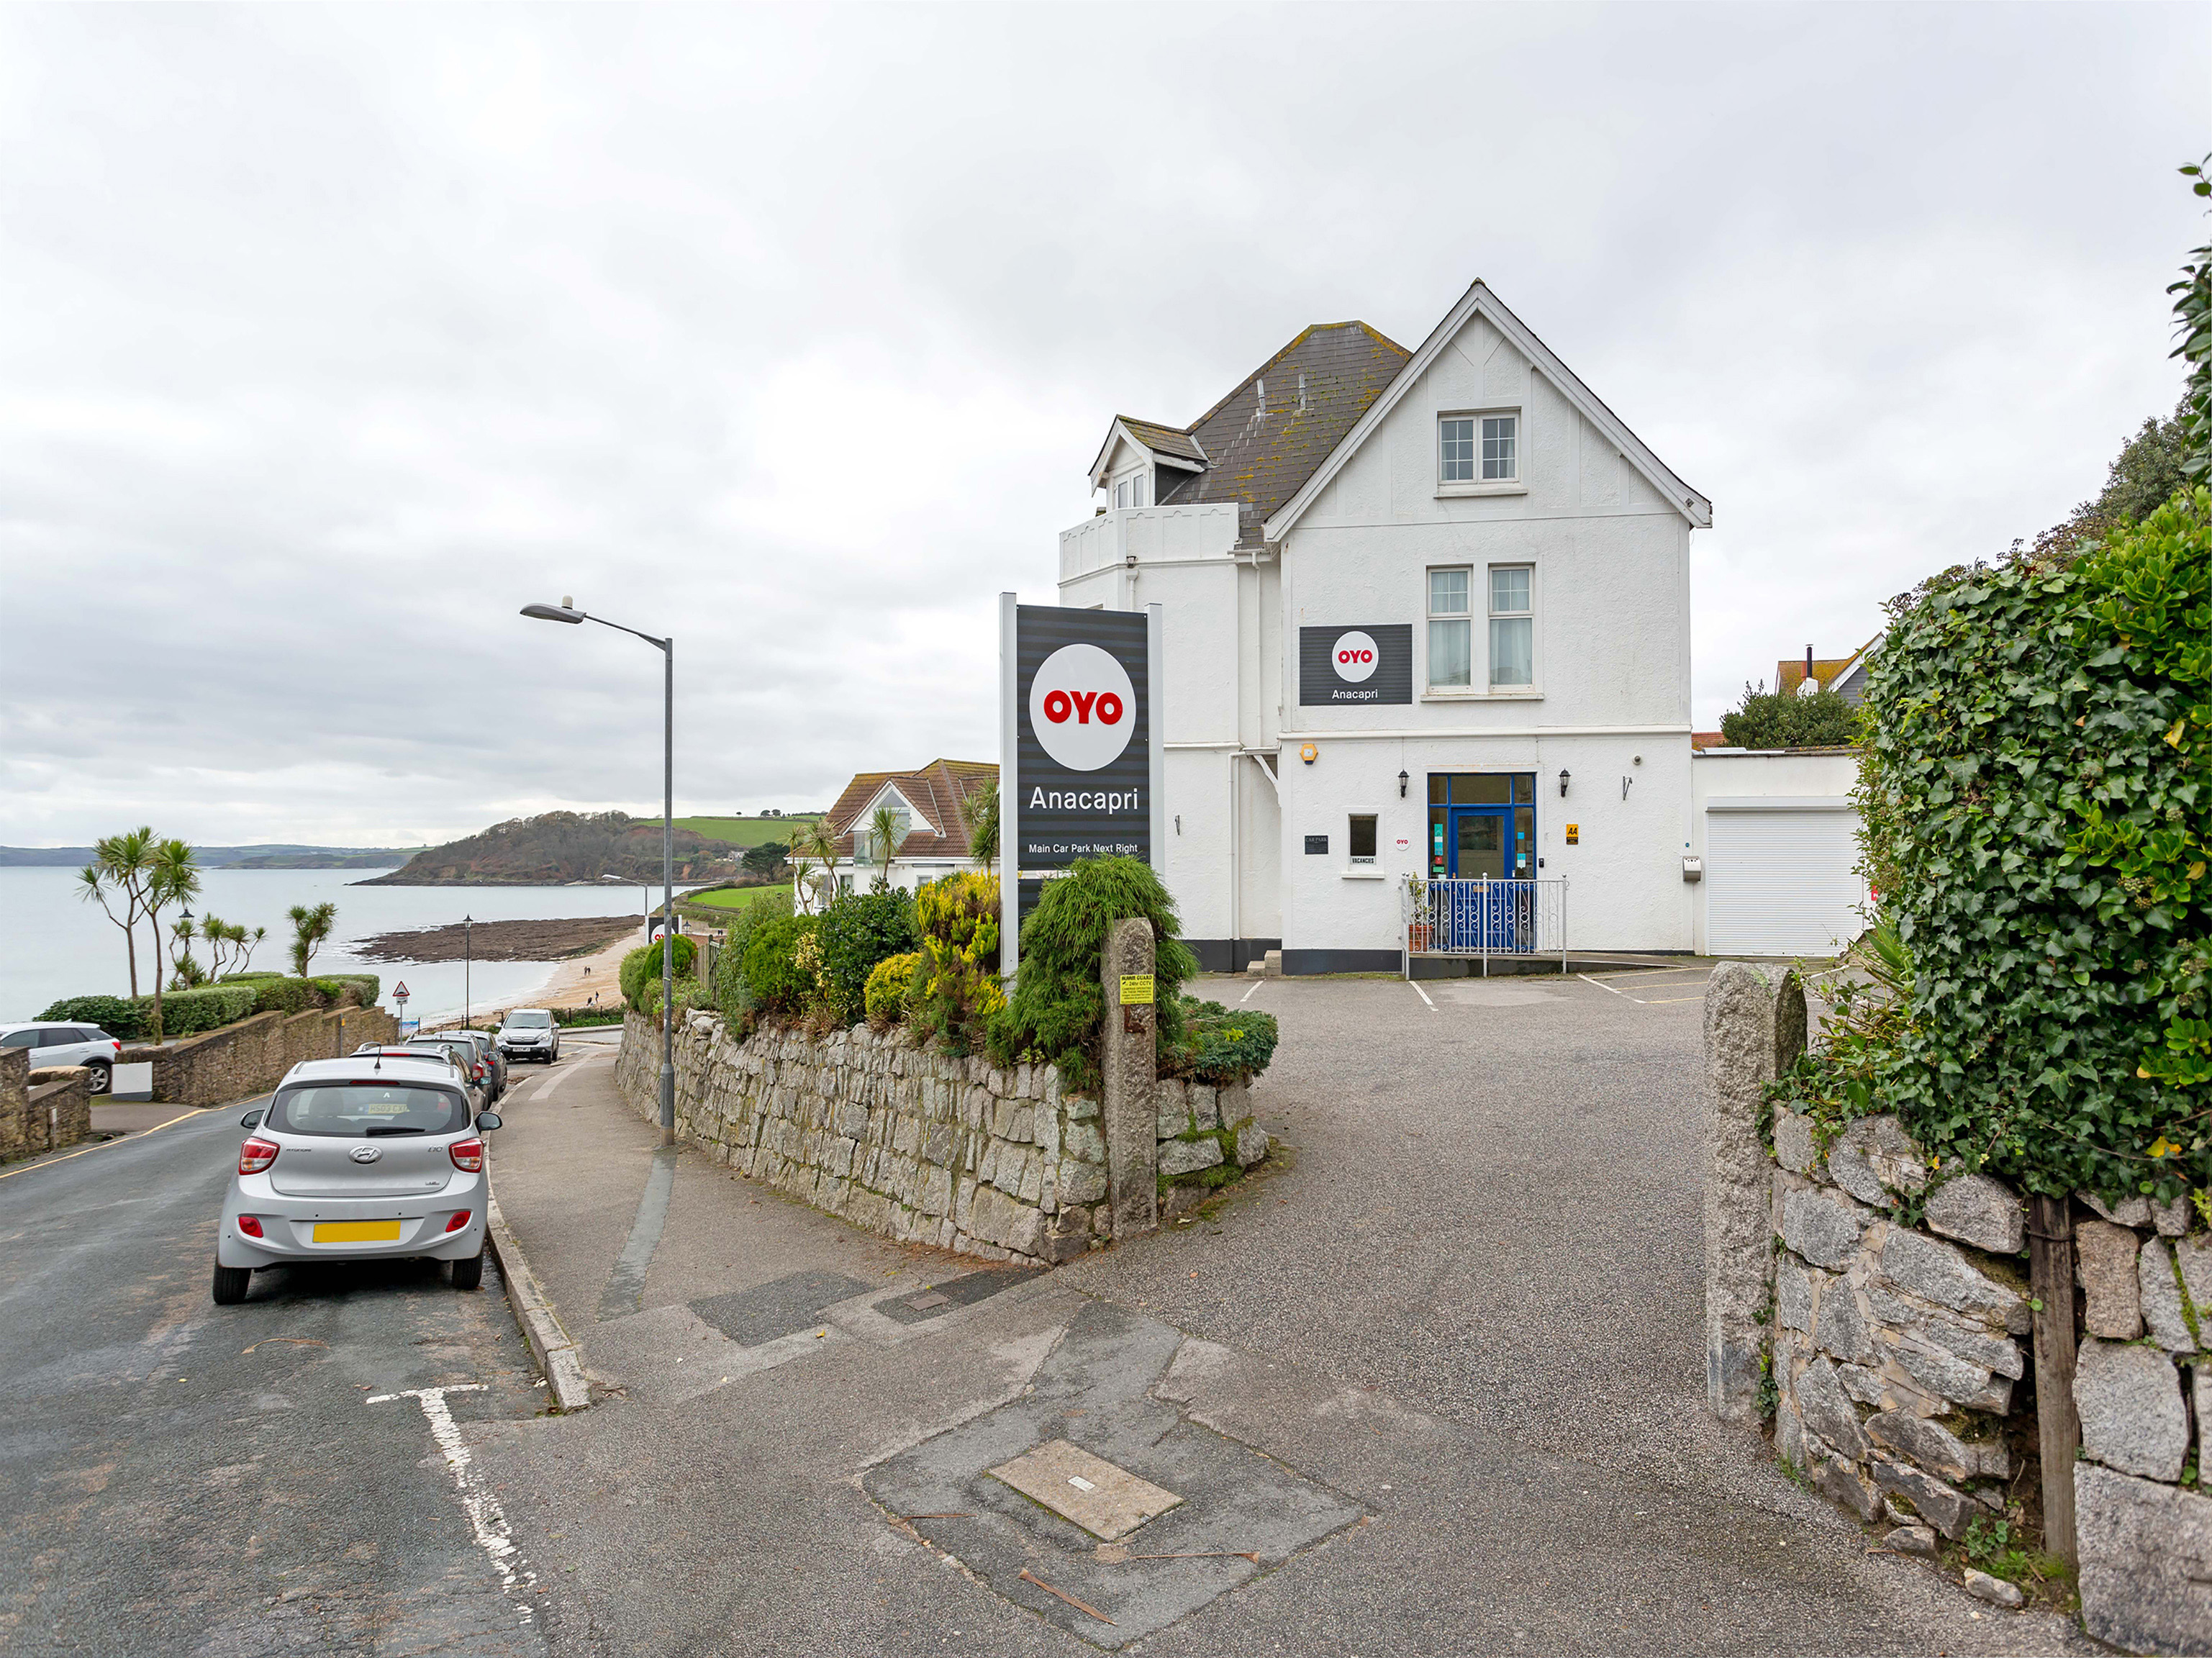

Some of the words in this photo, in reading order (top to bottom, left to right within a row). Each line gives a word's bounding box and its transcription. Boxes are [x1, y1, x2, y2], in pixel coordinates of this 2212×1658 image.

[1338, 649, 1373, 663] OYO
[1331, 689, 1378, 701] Anacapri
[1043, 689, 1123, 725] OYO
[1029, 787, 1138, 815] Anacapri
[1028, 843, 1051, 853] Main
[1053, 843, 1069, 853] Car
[1071, 843, 1091, 853] Park
[1093, 843, 1113, 853] Next
[1116, 843, 1138, 854] Right
